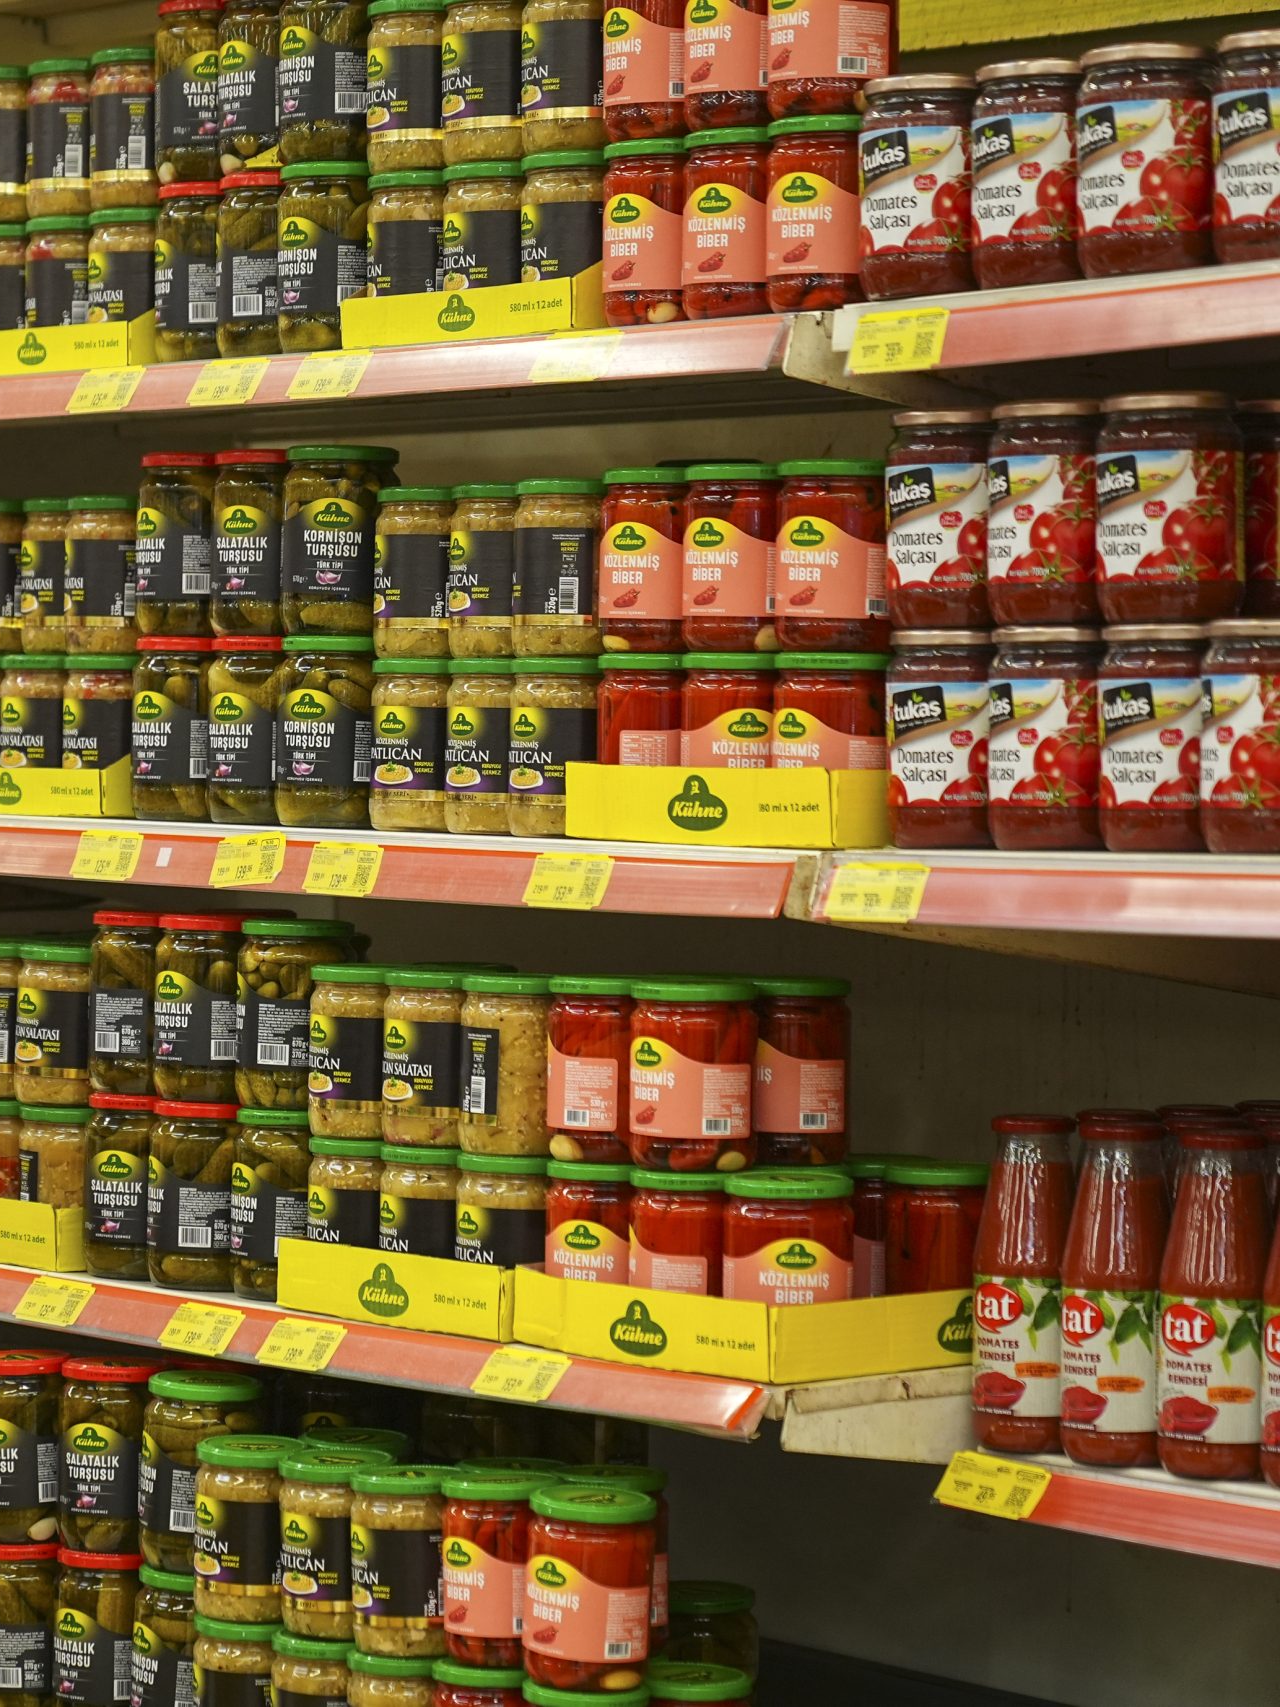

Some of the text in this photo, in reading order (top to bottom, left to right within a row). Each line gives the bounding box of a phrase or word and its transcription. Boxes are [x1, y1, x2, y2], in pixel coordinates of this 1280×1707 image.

[770, 30, 794, 45] BİBER
[689, 43, 716, 58] BİBER
[605, 58, 627, 72] BİBER
[1221, 161, 1280, 179] Domates
[1226, 180, 1273, 199] Salçası
[865, 194, 918, 213] Domates
[772, 206, 832, 223] KÖZLENMİŞ
[869, 213, 911, 230] Salçası
[688, 215, 746, 233] KÖZLENMİŞ
[781, 223, 815, 238] BİBER
[697, 232, 728, 248] BİBER
[610, 242, 638, 256] BİBER
[510, 303, 521, 313] 580
[522, 302, 530, 311] ml
[536, 301, 546, 310] 12
[547, 298, 563, 308] adet
[440, 312, 473, 324] Kühne
[224, 520, 254, 530] Kühne
[317, 513, 350, 523] Kühne
[216, 536, 268, 550] SALATALIK
[304, 529, 362, 544] KORNİŞON
[892, 531, 944, 546] Domates
[219, 550, 263, 564] TURŞUSU
[306, 544, 358, 559] TURŞUSU
[685, 548, 739, 566] KÖZLENMİŞ
[780, 548, 839, 566] KÖZLENMİŞ
[895, 549, 936, 566] Salçası
[239, 566, 249, 574] TİPİ
[316, 561, 343, 569] TÜRK TİPİ
[604, 554, 660, 571] KÖZLENMİŞ
[612, 568, 643, 585] BİBER
[692, 565, 721, 582] BİBER
[788, 566, 821, 582] BİBER
[215, 707, 240, 716] Kühne
[293, 705, 323, 714] Kühne
[209, 723, 253, 736] SALATALIK
[284, 720, 335, 735] KORNİŞON
[730, 724, 766, 734] Kühne
[210, 735, 248, 750] TURŞUSU
[286, 735, 331, 749] TURŞUSU
[375, 737, 409, 746] KÖZLENMİŞ
[227, 752, 236, 761] TİPİ
[293, 751, 316, 760] TÜRK TİPİ
[371, 747, 422, 761] PATLICAN
[897, 748, 954, 764] Domates
[1107, 748, 1164, 764] Domates
[902, 766, 947, 784] Salçası
[1112, 767, 1157, 784] Salçası
[671, 800, 723, 818] Kühne
[634, 1088, 659, 1102] BİBER
[101, 1165, 128, 1174] Kühne
[91, 1179, 142, 1194] SALATALIK
[93, 1193, 138, 1208] TURŞUSU
[101, 1210, 124, 1218] TÜRK TİPİ
[0, 1230, 10, 1240] 580
[12, 1231, 19, 1241] ml
[24, 1232, 32, 1242] 12
[32, 1233, 46, 1244] adet
[554, 1249, 614, 1271] KÖZLENMİŞ
[759, 1270, 830, 1290] KÖZLENMİŞ
[362, 1286, 405, 1306] Kühne
[433, 1293, 445, 1304] 580
[446, 1295, 454, 1305] ml
[462, 1297, 471, 1307] 12
[471, 1299, 487, 1311] adet
[775, 1289, 814, 1305] BİBER
[976, 1294, 1016, 1321] tat
[1062, 1306, 1096, 1334] tat
[614, 1324, 664, 1347] Kühne
[1164, 1314, 1207, 1344] tat
[977, 1338, 1020, 1350] DOMATES
[1166, 1359, 1212, 1373] DOMATES
[1168, 1373, 1208, 1387] RENDESİ
[75, 1438, 105, 1448] Kühne
[65, 1452, 119, 1468] SALATALIK
[68, 1466, 115, 1483] TURŞUSU
[76, 1484, 101, 1493] TÜRK TİPİ
[446, 1585, 470, 1602] BİBER
[533, 1603, 562, 1623] BİBER
